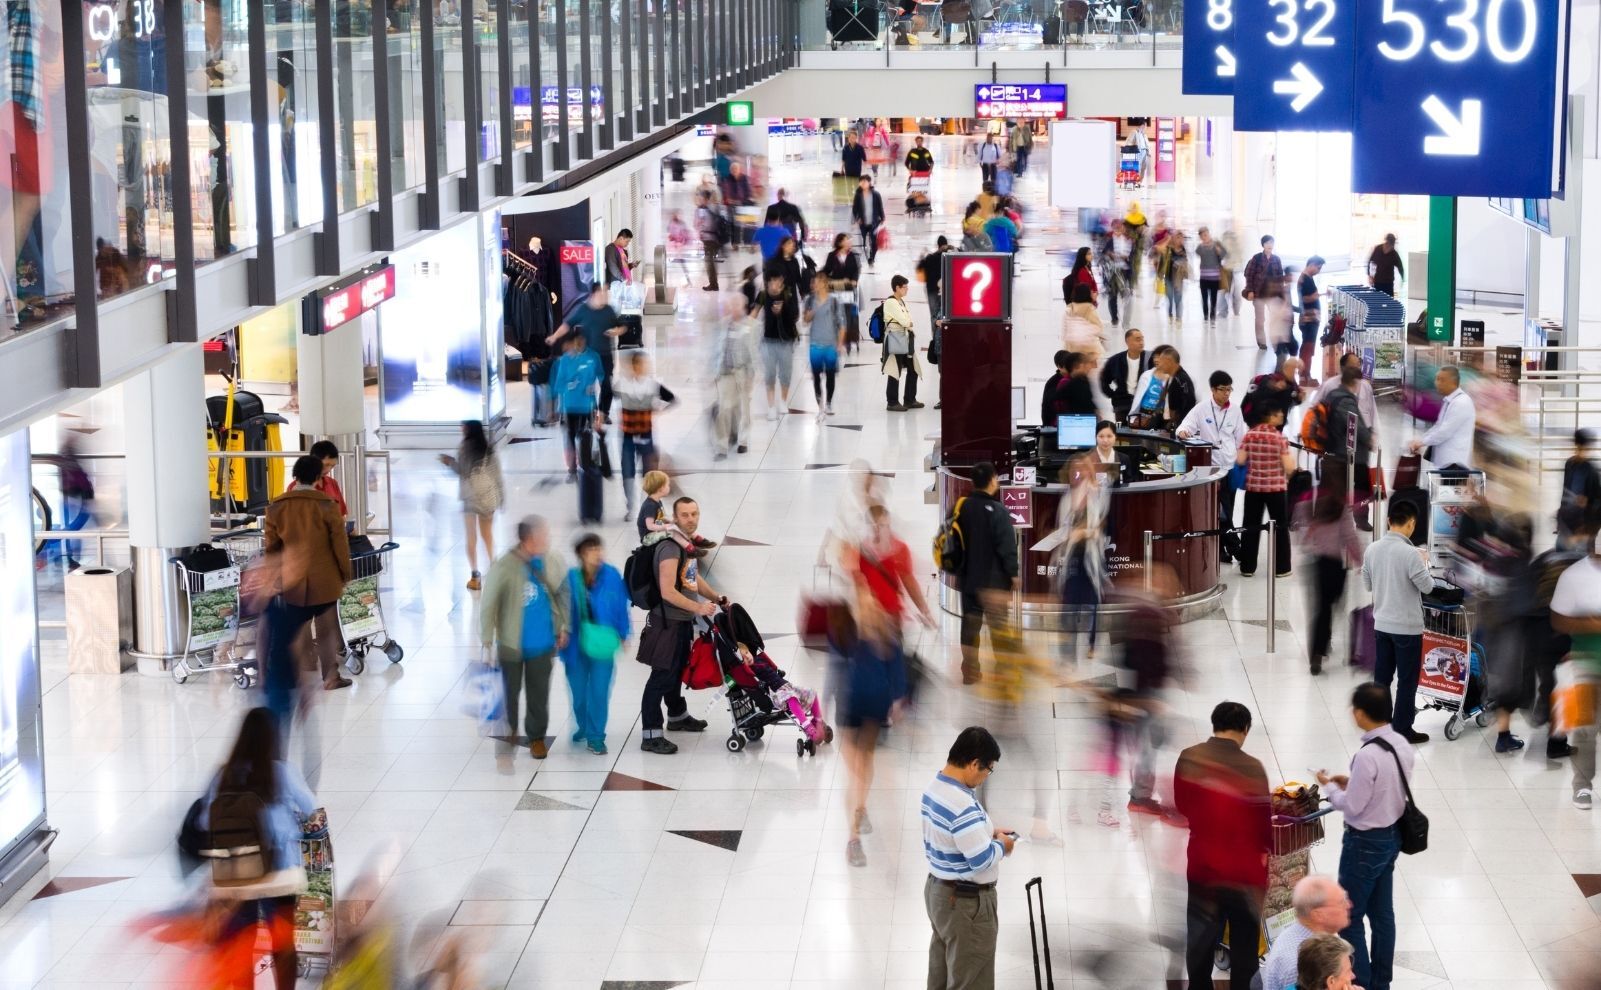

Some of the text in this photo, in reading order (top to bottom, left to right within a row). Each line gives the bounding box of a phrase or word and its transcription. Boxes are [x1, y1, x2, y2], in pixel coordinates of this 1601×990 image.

[1266, 0, 1336, 46] 32
[1377, 0, 1537, 62] 530
[1022, 88, 1041, 100] 1-4
[562, 249, 592, 261] SALE
[1005, 492, 1027, 501] 入口
